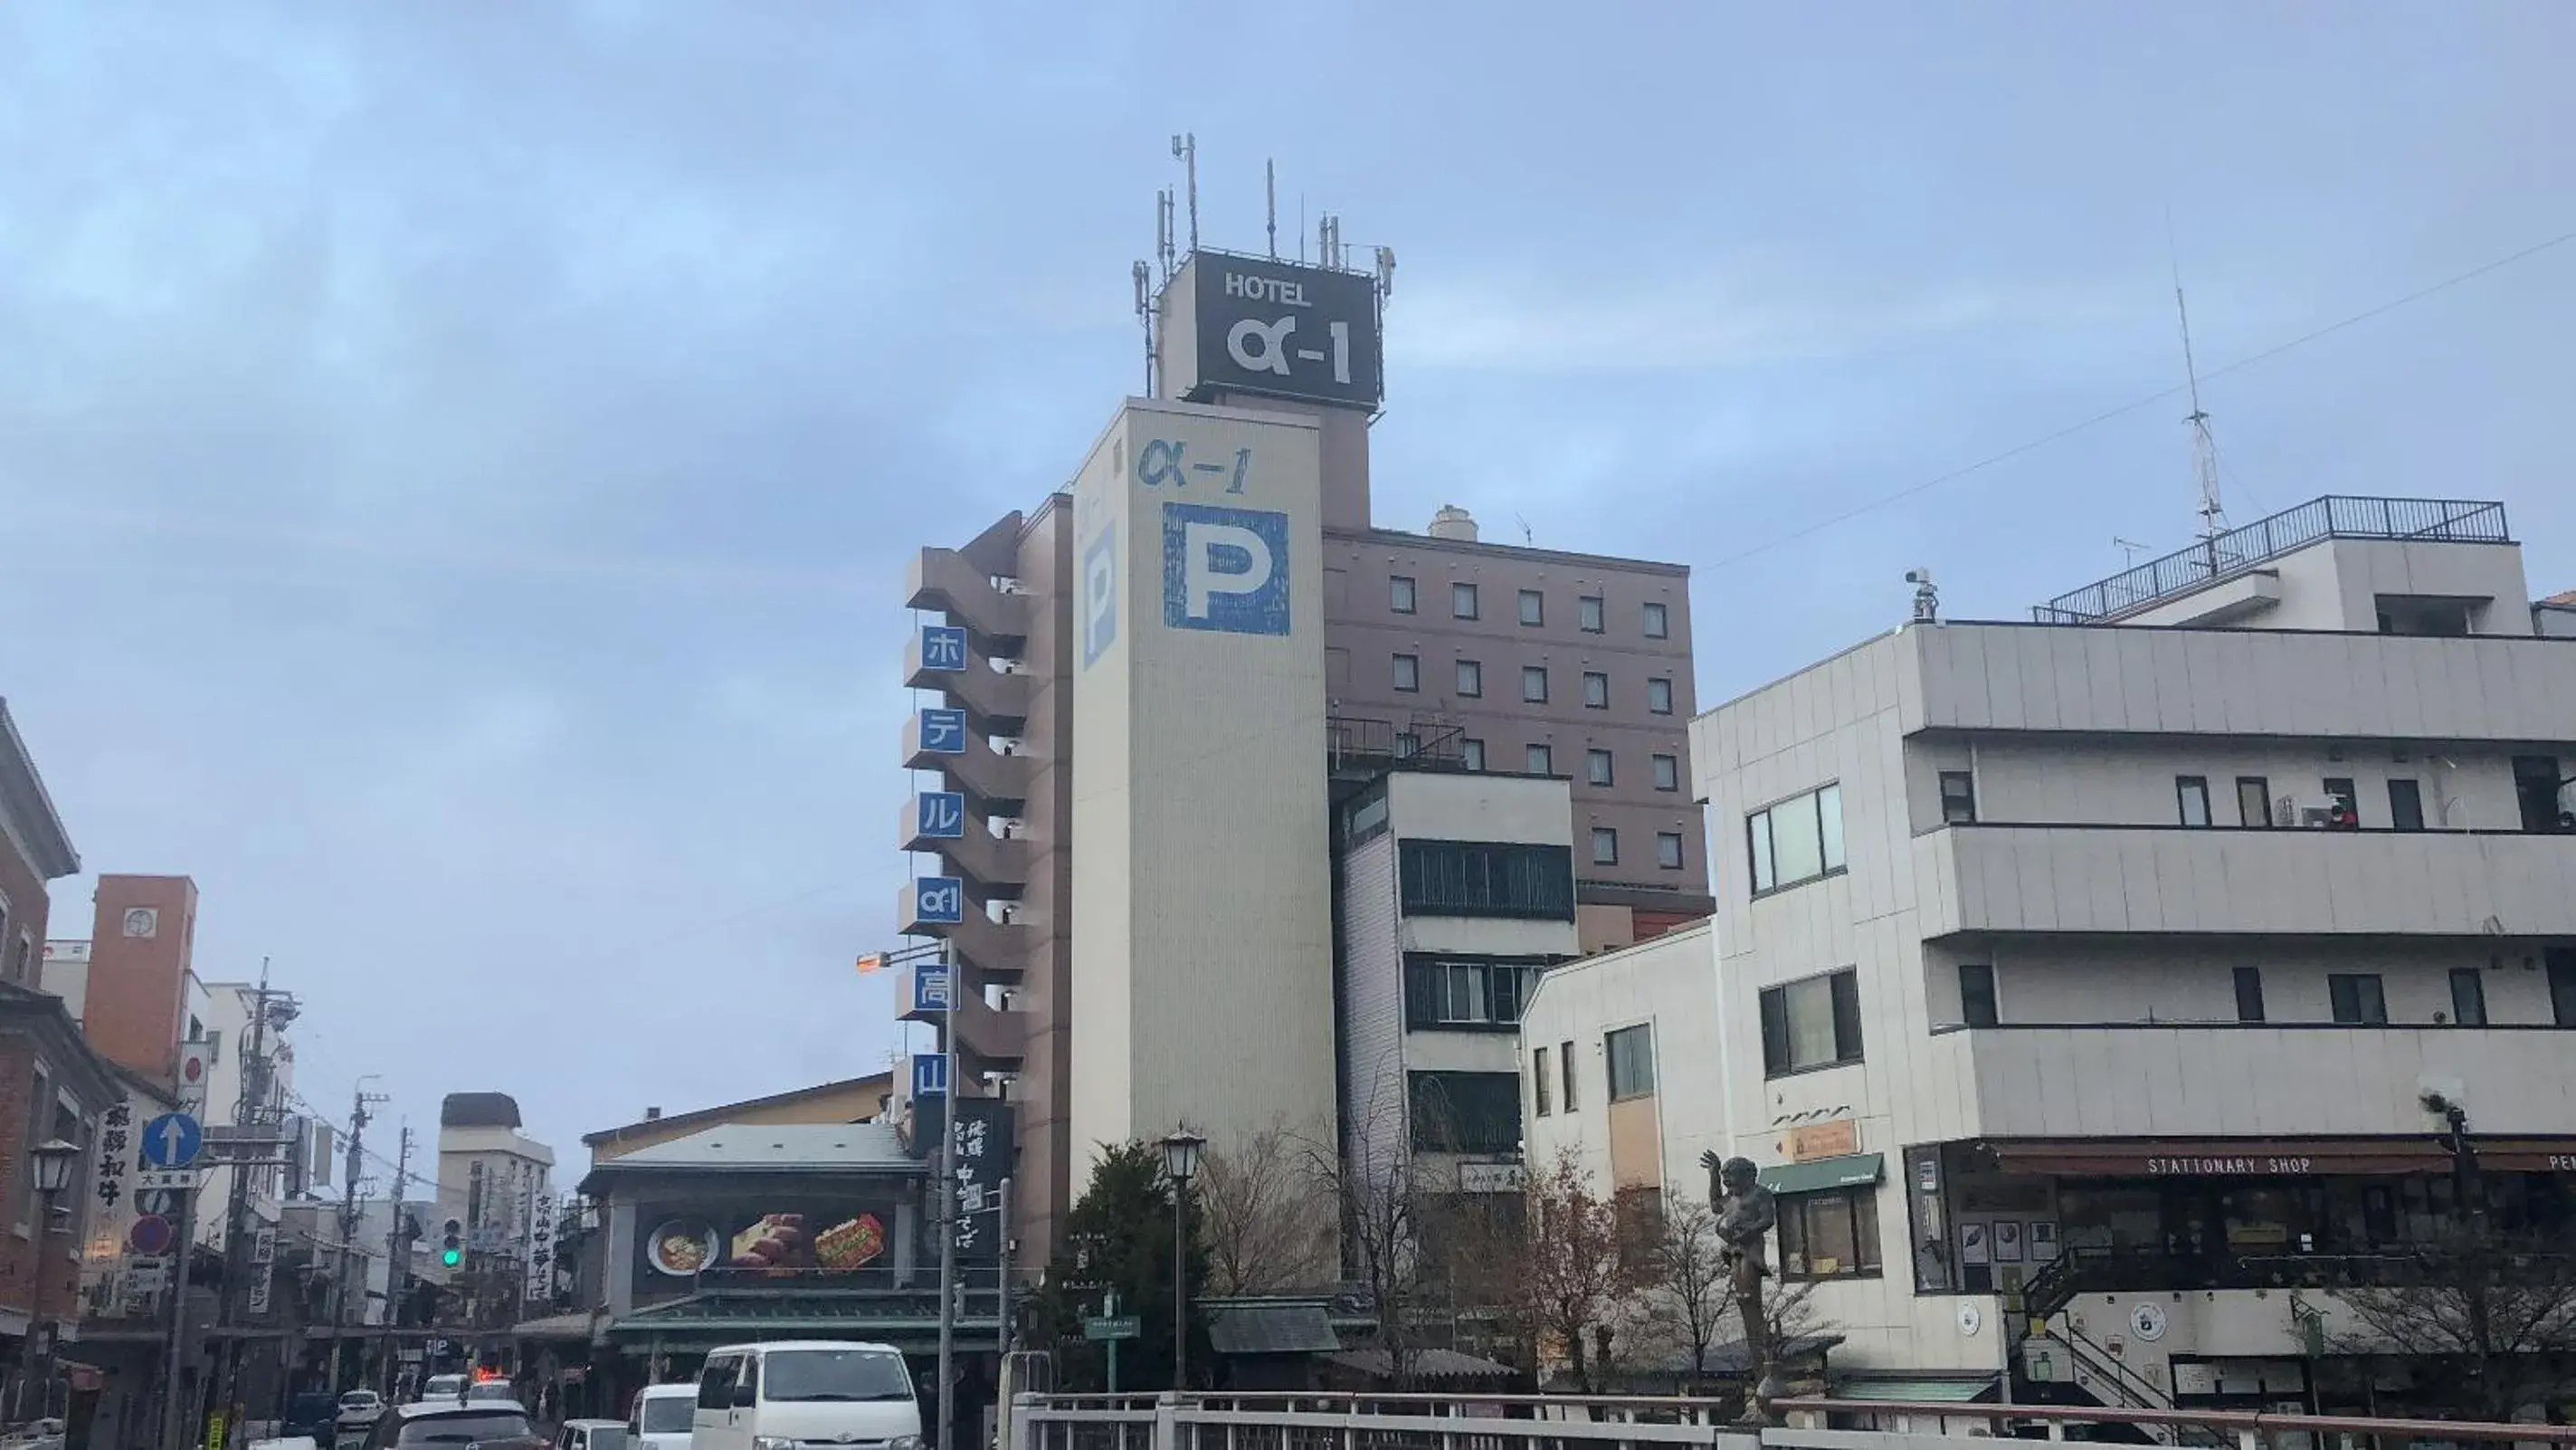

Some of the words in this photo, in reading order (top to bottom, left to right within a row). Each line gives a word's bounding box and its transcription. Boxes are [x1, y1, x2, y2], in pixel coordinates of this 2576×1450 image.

[1225, 272, 1312, 307] HOTEL
[1227, 316, 1351, 385] α-1
[1137, 438, 1252, 495] α-1
[1086, 547, 1113, 655] P
[1184, 521, 1274, 619] P
[2148, 1158, 2256, 1174] STATIONARY
[2268, 1158, 2311, 1174] SHOP
